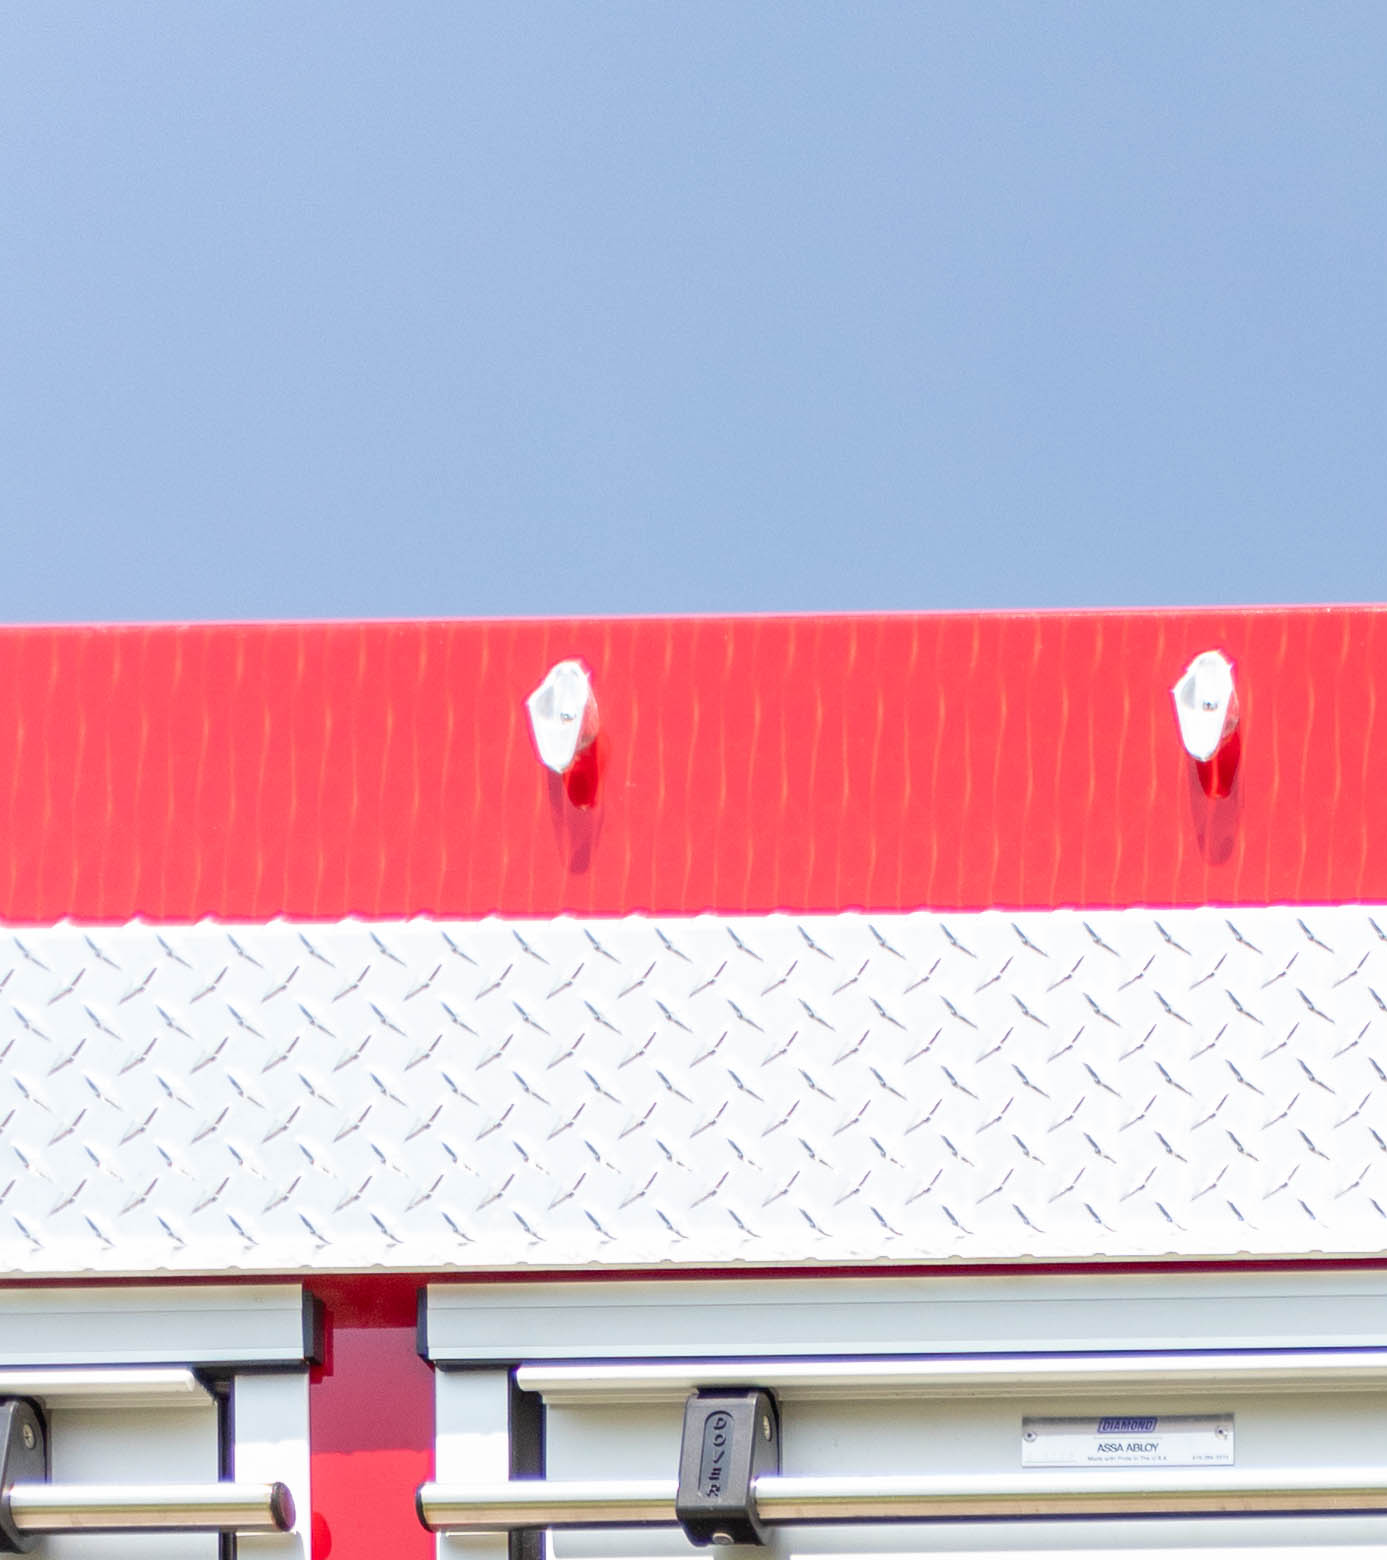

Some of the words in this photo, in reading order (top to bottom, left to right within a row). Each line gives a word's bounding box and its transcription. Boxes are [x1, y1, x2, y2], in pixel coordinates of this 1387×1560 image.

[1102, 1419, 1154, 1432] DIAMOND
[1097, 1443, 1124, 1453] ASSA
[1126, 1443, 1159, 1453] ABLOY
[706, 1417, 728, 1498] DOVER
